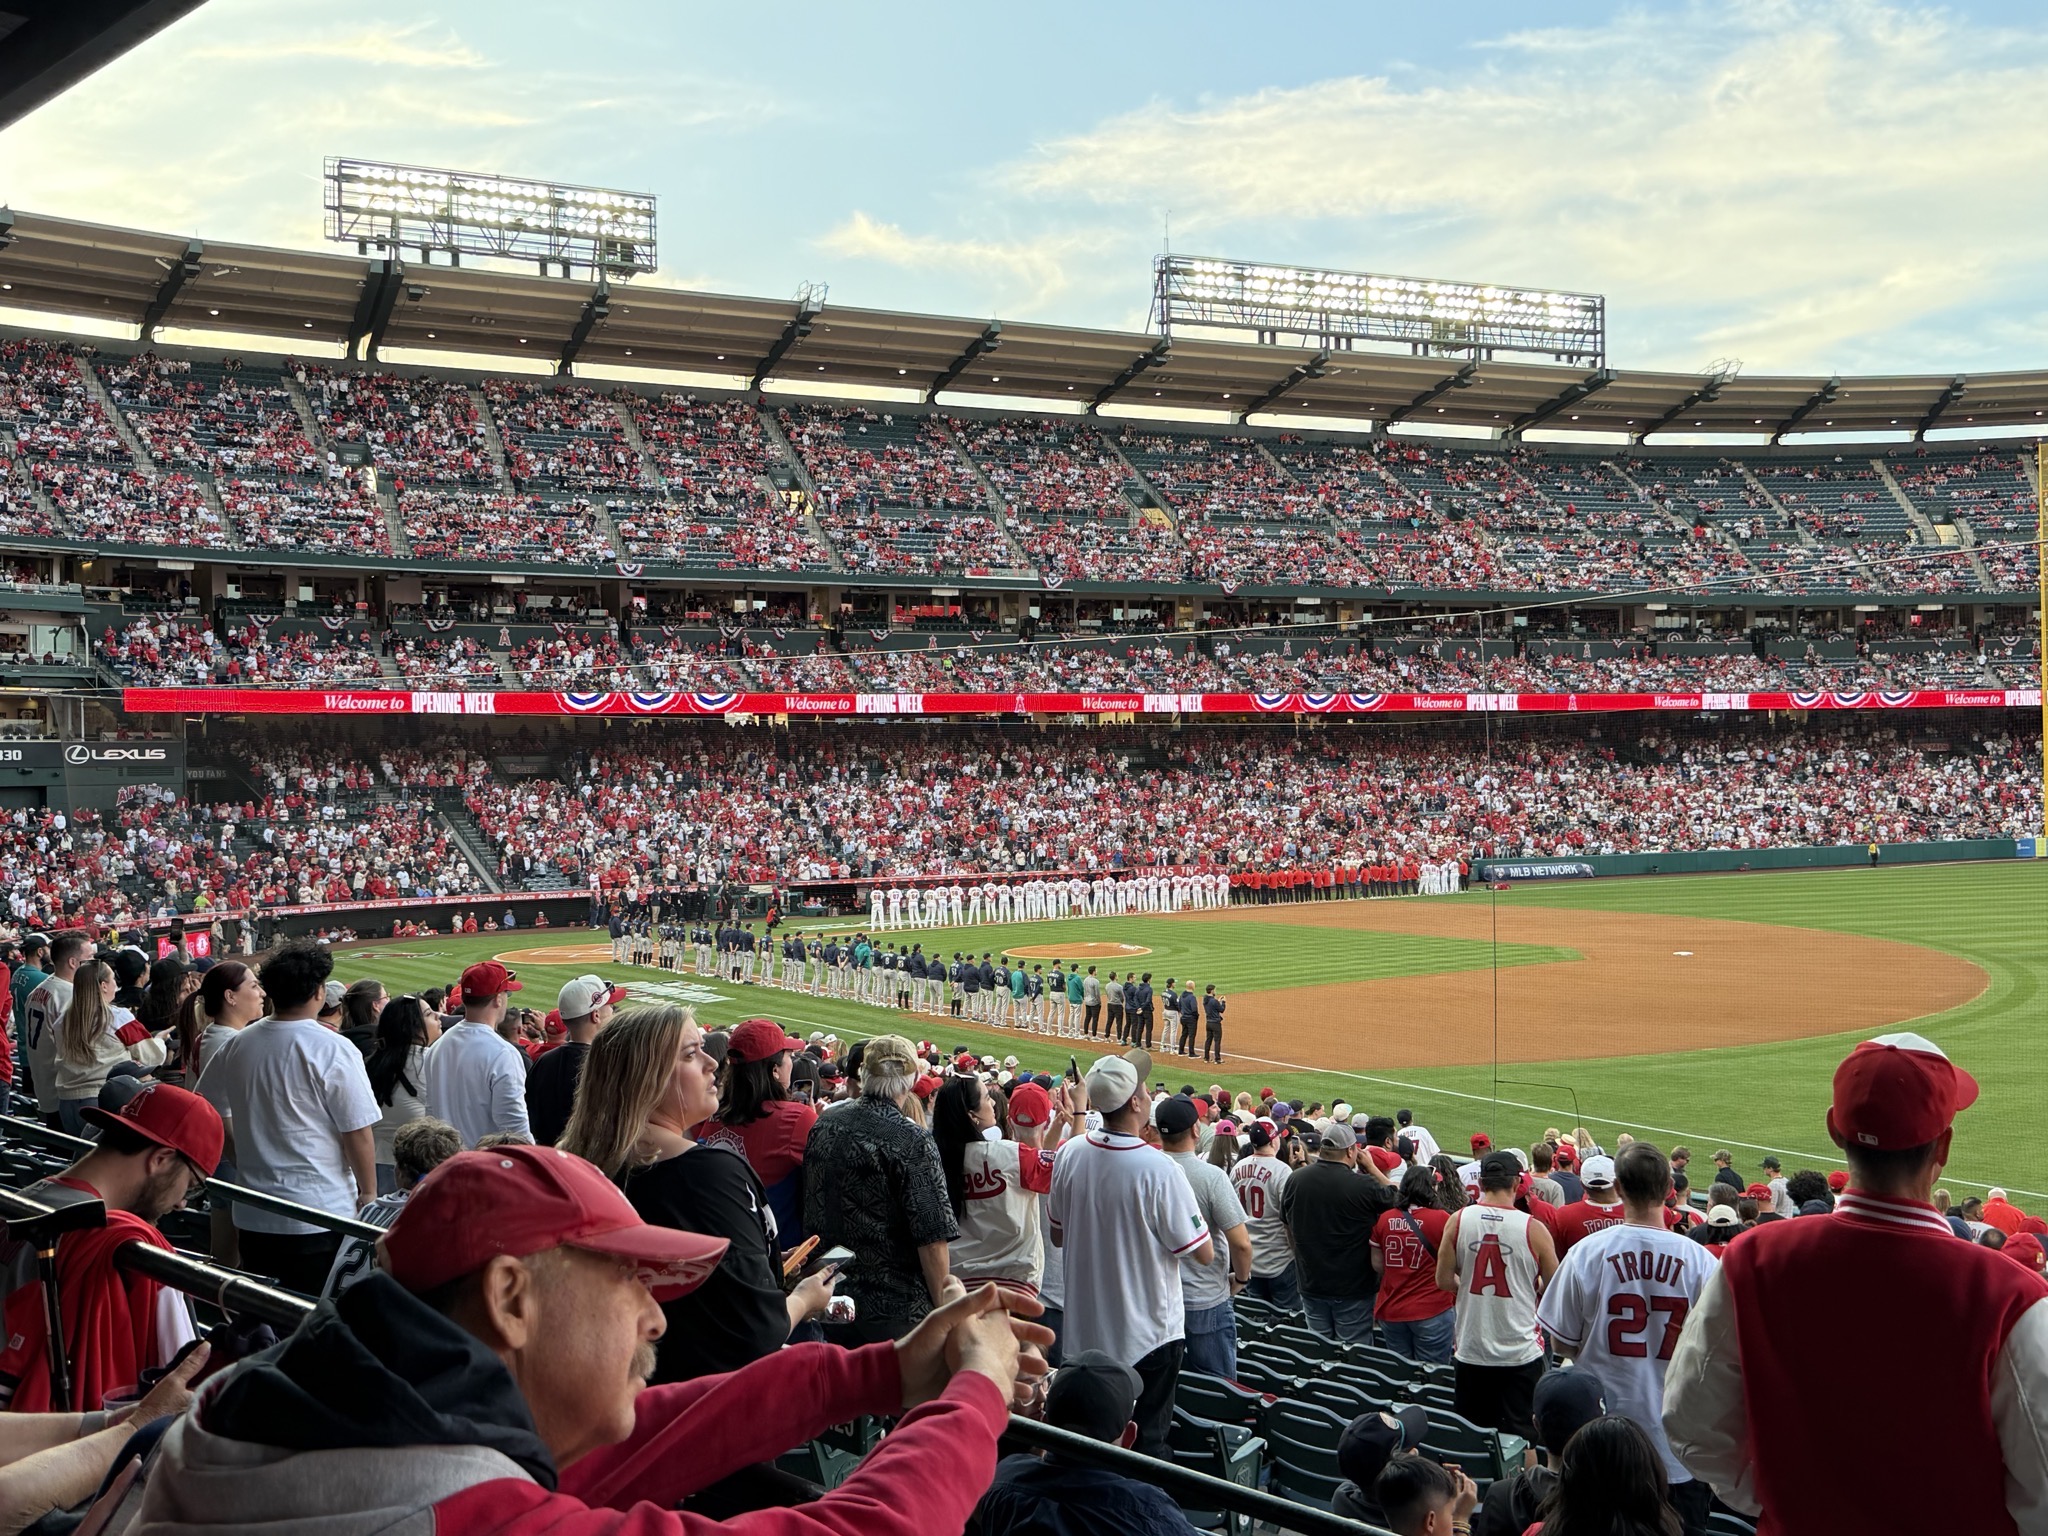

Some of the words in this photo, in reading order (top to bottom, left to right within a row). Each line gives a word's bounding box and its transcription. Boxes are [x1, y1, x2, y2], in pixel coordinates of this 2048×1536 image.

[324, 694, 388, 710] Welcome
[390, 696, 404, 710] to
[412, 692, 462, 713] OPENING
[463, 693, 496, 714] WEEK
[785, 696, 837, 710] Welcome
[839, 697, 850, 710] to
[856, 694, 896, 713] OPENING
[897, 694, 923, 713] WEEK
[1082, 697, 1127, 710] Welcome
[1128, 698, 1138, 709] to
[1143, 694, 1179, 712] OPENING
[1180, 694, 1203, 712] WEEK
[1413, 696, 1453, 709] Welcome
[1453, 698, 1463, 709] to
[1498, 694, 1519, 711] WEEK
[1654, 696, 1690, 707] Welcome
[1691, 697, 1699, 707] to
[1945, 693, 1989, 704] Welcome
[1990, 694, 2000, 704] to
[2005, 690, 2041, 706] OPENING
[91, 749, 166, 760] LEXUS
[1509, 867, 1531, 877] MLB
[1532, 865, 1578, 876] NETWORK
[28, 1007, 44, 1050] 17
[1085, 1119, 1099, 1131] OUT
[963, 1161, 1007, 1200] gels
[1235, 1163, 1272, 1184] HUDLER
[1239, 1184, 1265, 1219] 10
[1385, 1235, 1424, 1269] 27
[1469, 1233, 1513, 1298] A
[1606, 1250, 1686, 1287] TROUT
[1607, 1293, 1689, 1361] 27
